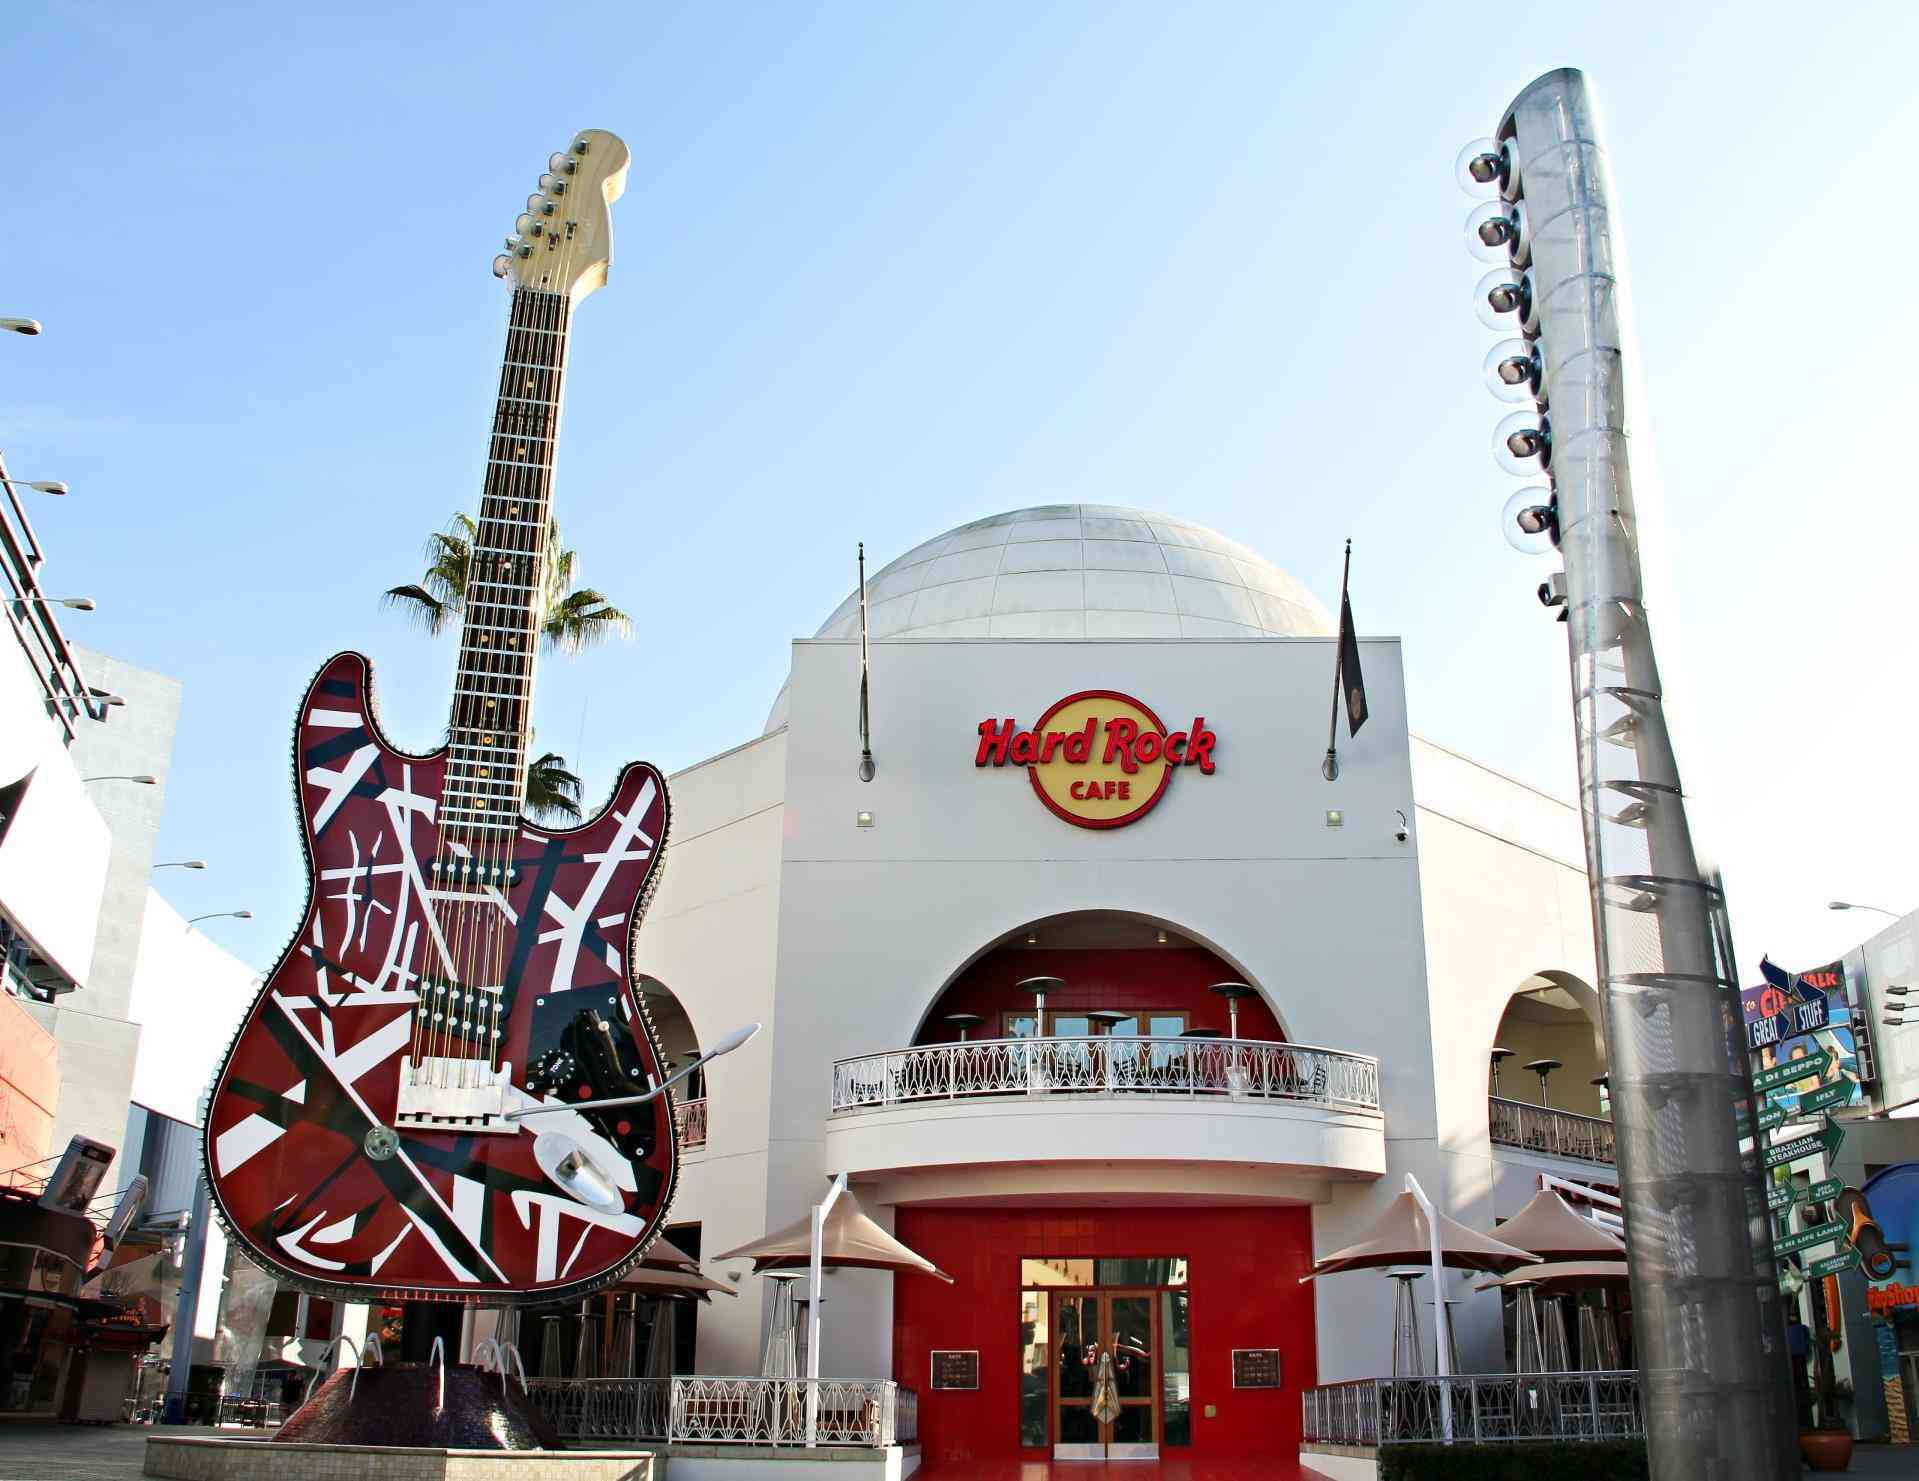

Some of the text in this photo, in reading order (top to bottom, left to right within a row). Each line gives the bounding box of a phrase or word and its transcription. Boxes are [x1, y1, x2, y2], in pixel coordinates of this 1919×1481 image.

[975, 717, 1216, 775] Hard Rock
[1070, 781, 1131, 800] CAFE
[1753, 1000, 1823, 1047] GREAT STUFF
[1782, 1057, 1823, 1076] BEPPO
[1766, 1140, 1824, 1164] STEAKHOUSE
[1769, 1135, 1814, 1156] BRAZILIAN
